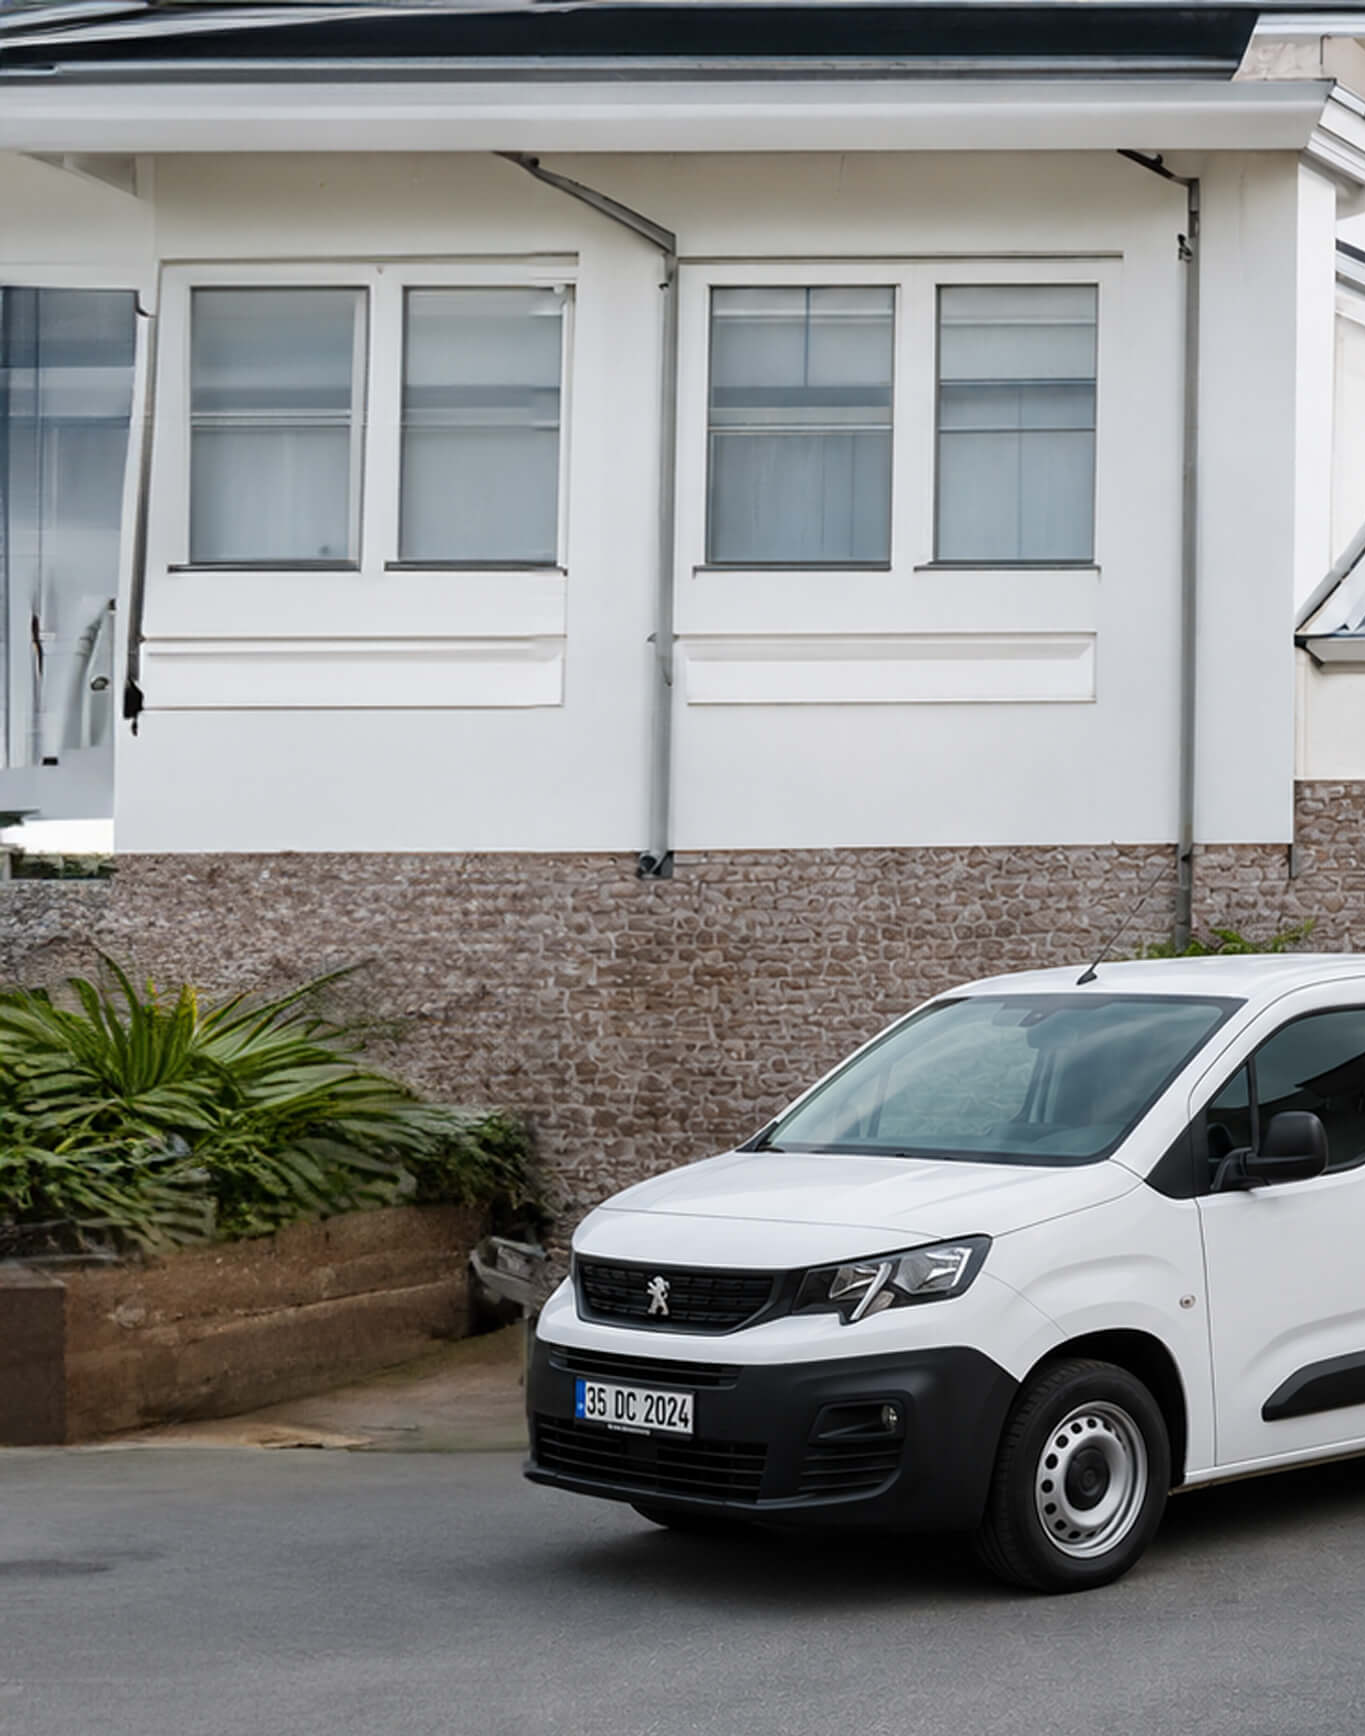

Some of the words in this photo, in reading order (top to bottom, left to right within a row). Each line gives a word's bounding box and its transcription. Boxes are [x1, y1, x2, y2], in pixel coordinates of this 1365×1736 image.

[587, 1386, 606, 1416] 35
[615, 1390, 636, 1421] DC
[644, 1394, 689, 1429] 2024
